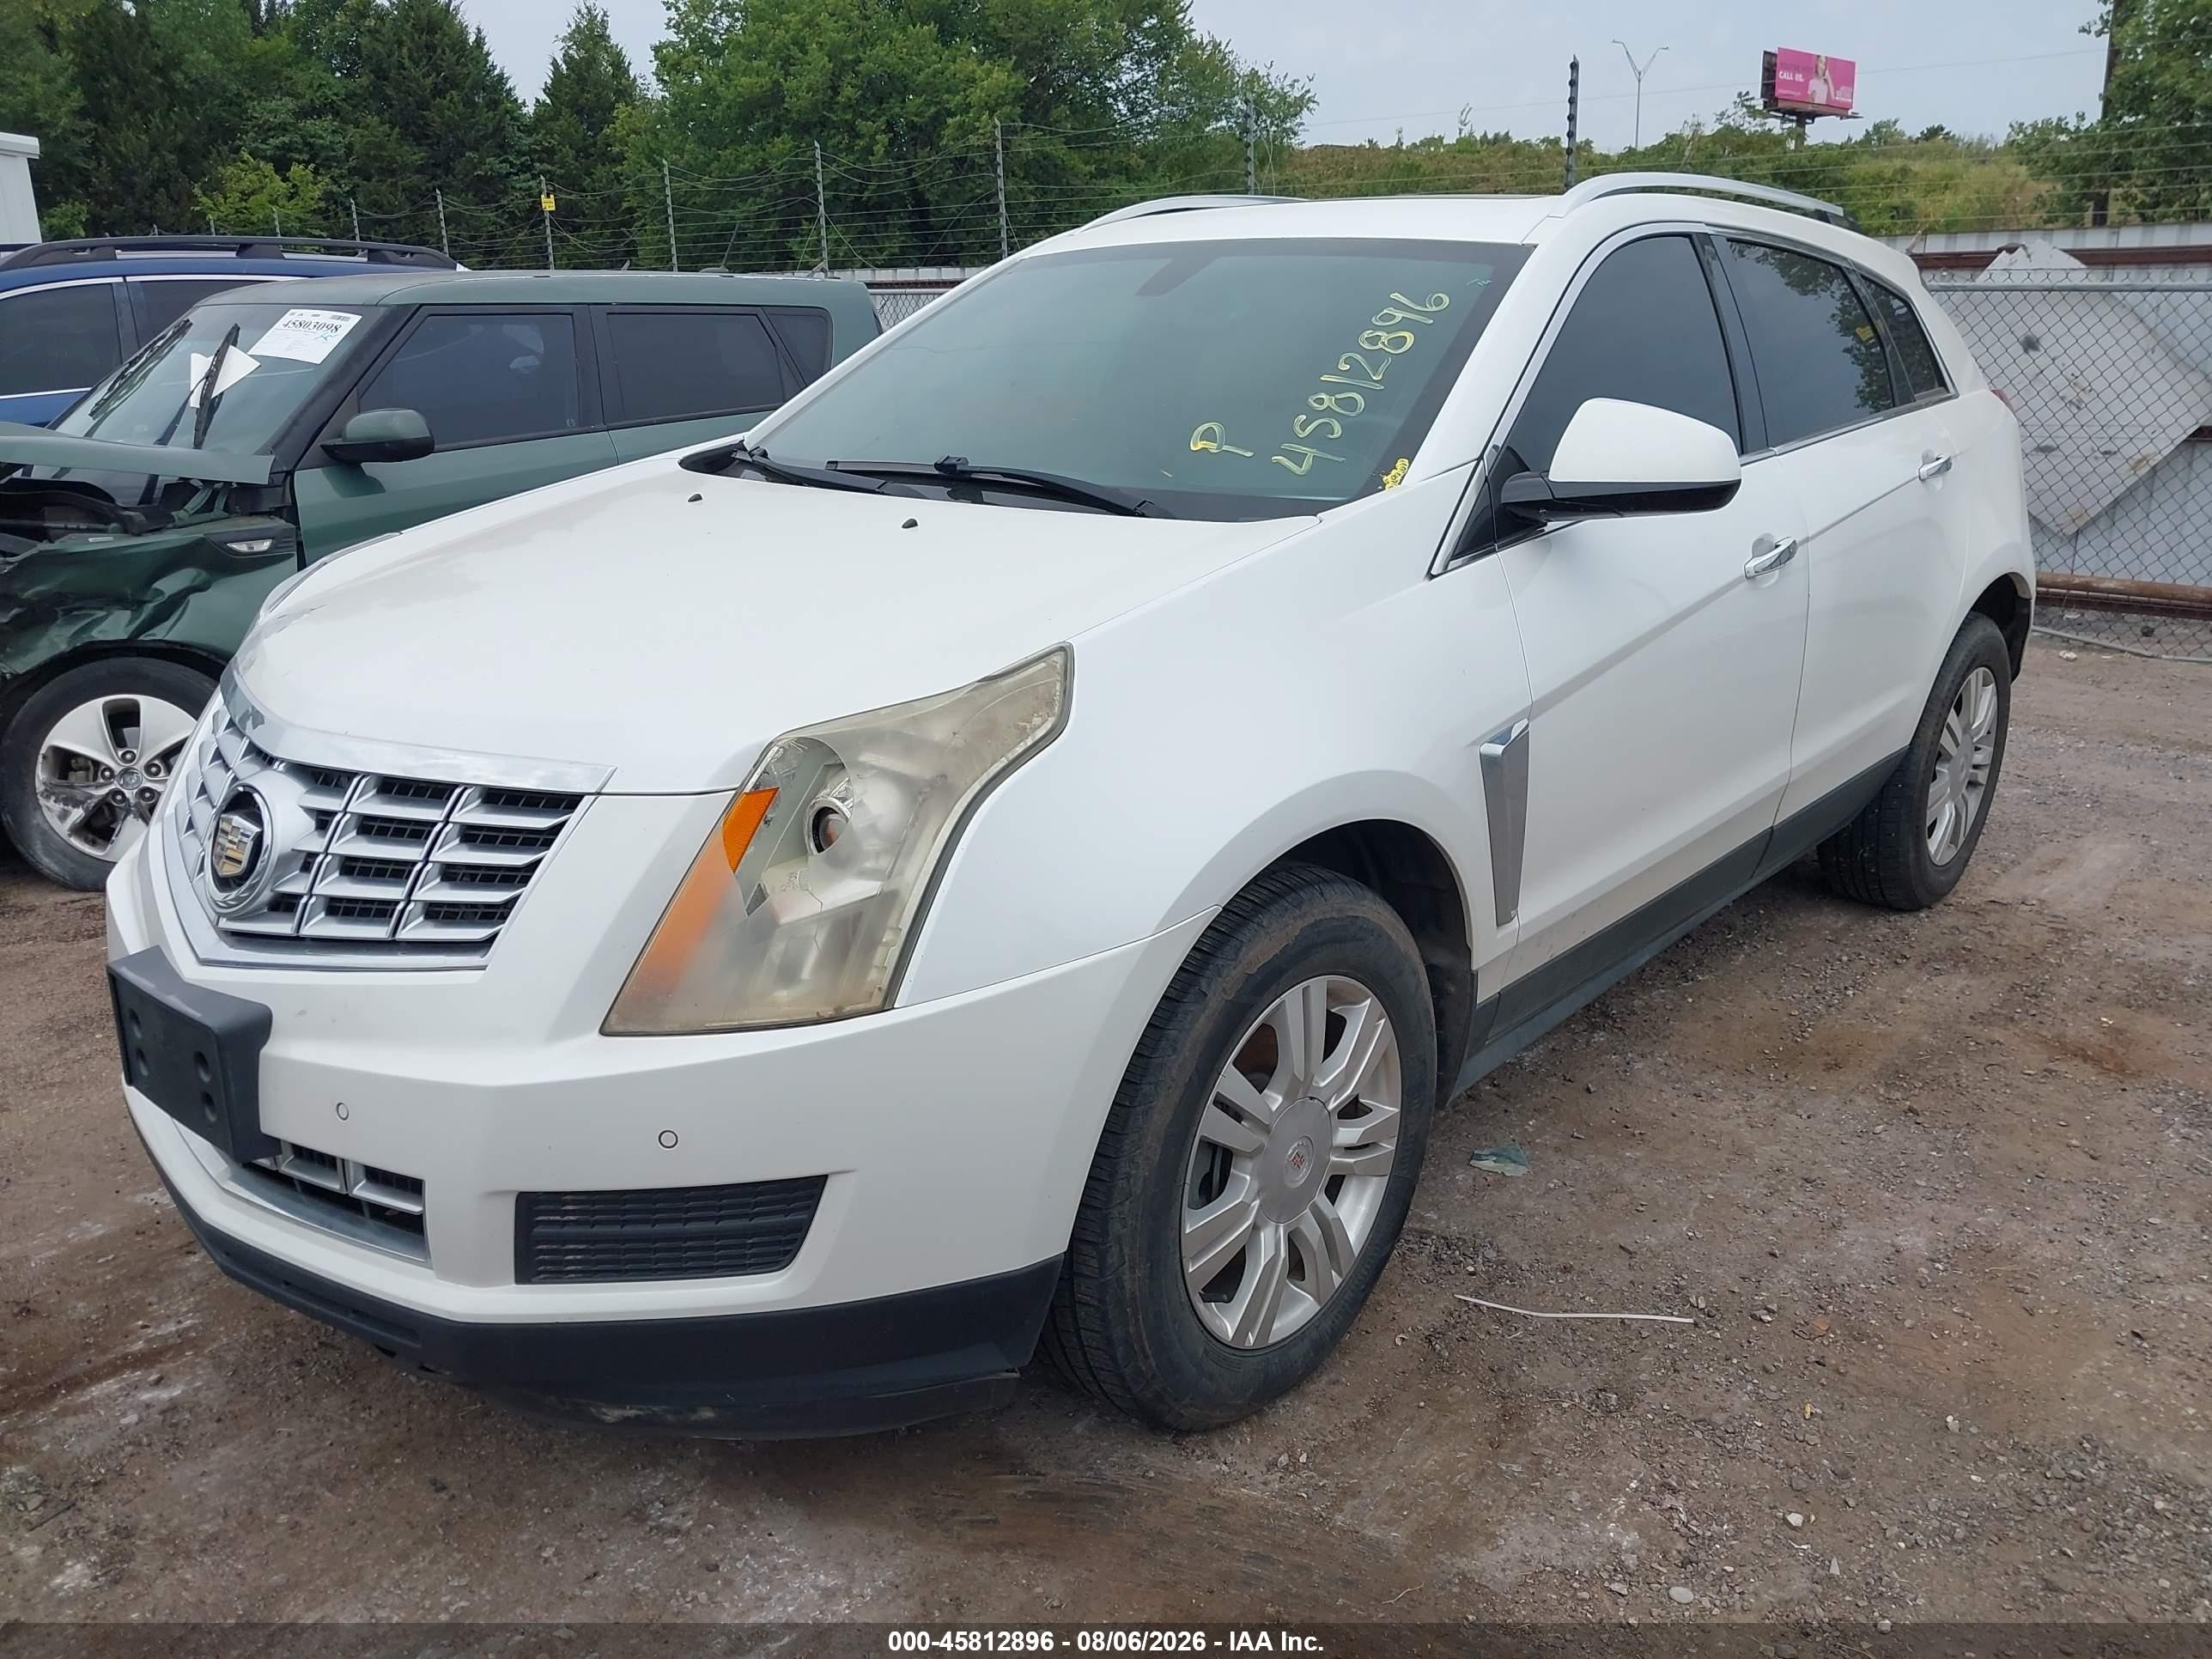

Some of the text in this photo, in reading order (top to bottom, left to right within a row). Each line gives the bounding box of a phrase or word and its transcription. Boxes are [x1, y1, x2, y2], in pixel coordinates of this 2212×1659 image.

[1778, 70, 1794, 81] CALL
[282, 319, 342, 334] 45803098
[1271, 292, 1450, 475] 45812896
[1189, 422, 1255, 458] P
